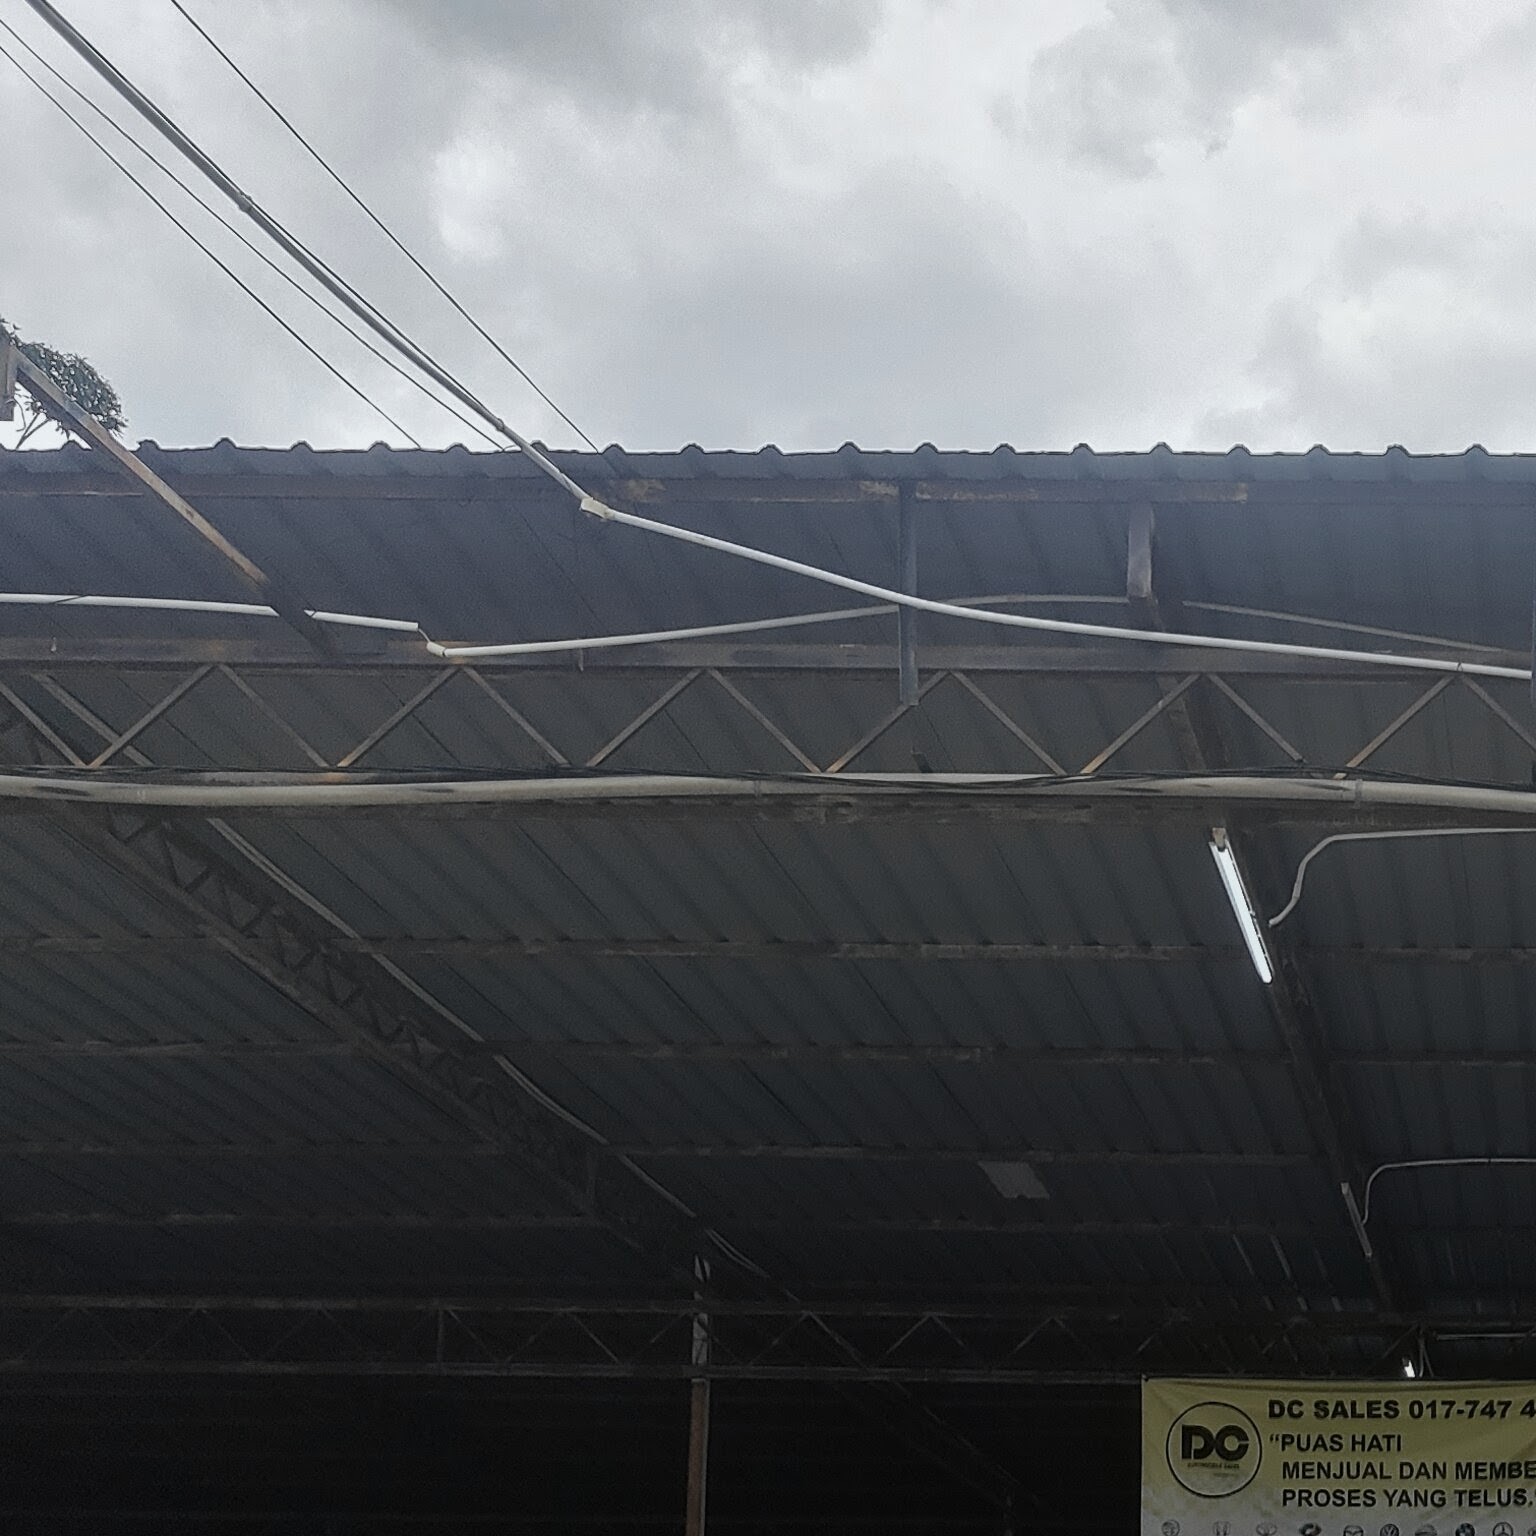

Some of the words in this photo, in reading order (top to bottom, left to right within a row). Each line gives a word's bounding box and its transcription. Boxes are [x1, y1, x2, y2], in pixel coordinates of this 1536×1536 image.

[1268, 1400, 1304, 1420] DC
[1313, 1400, 1400, 1420] SALES
[1408, 1399, 1512, 1419] 017-747
[1181, 1424, 1250, 1462] DC
[1351, 1434, 1402, 1453] HATI
[1282, 1461, 1392, 1480] MENJUAL
[1399, 1461, 1448, 1480] DAN
[1282, 1488, 1377, 1508] PROSES
[1383, 1488, 1447, 1508] YANG
